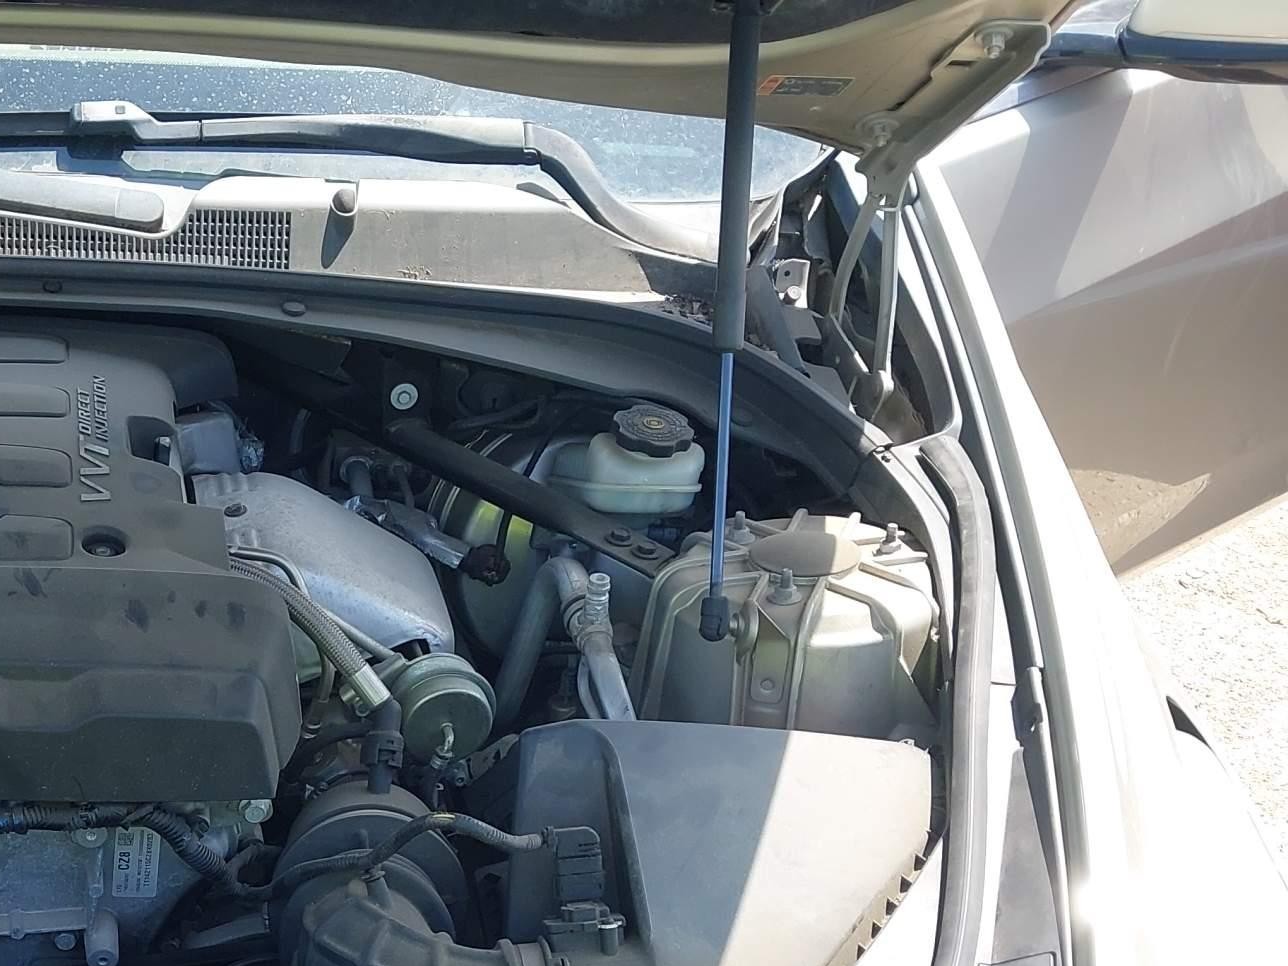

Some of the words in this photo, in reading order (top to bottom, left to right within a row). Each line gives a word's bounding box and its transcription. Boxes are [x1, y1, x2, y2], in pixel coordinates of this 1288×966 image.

[77, 386, 91, 436] DIRECT
[93, 374, 108, 442] INJECTION
[79, 434, 111, 502] VVT
[118, 851, 131, 870] CZ8
